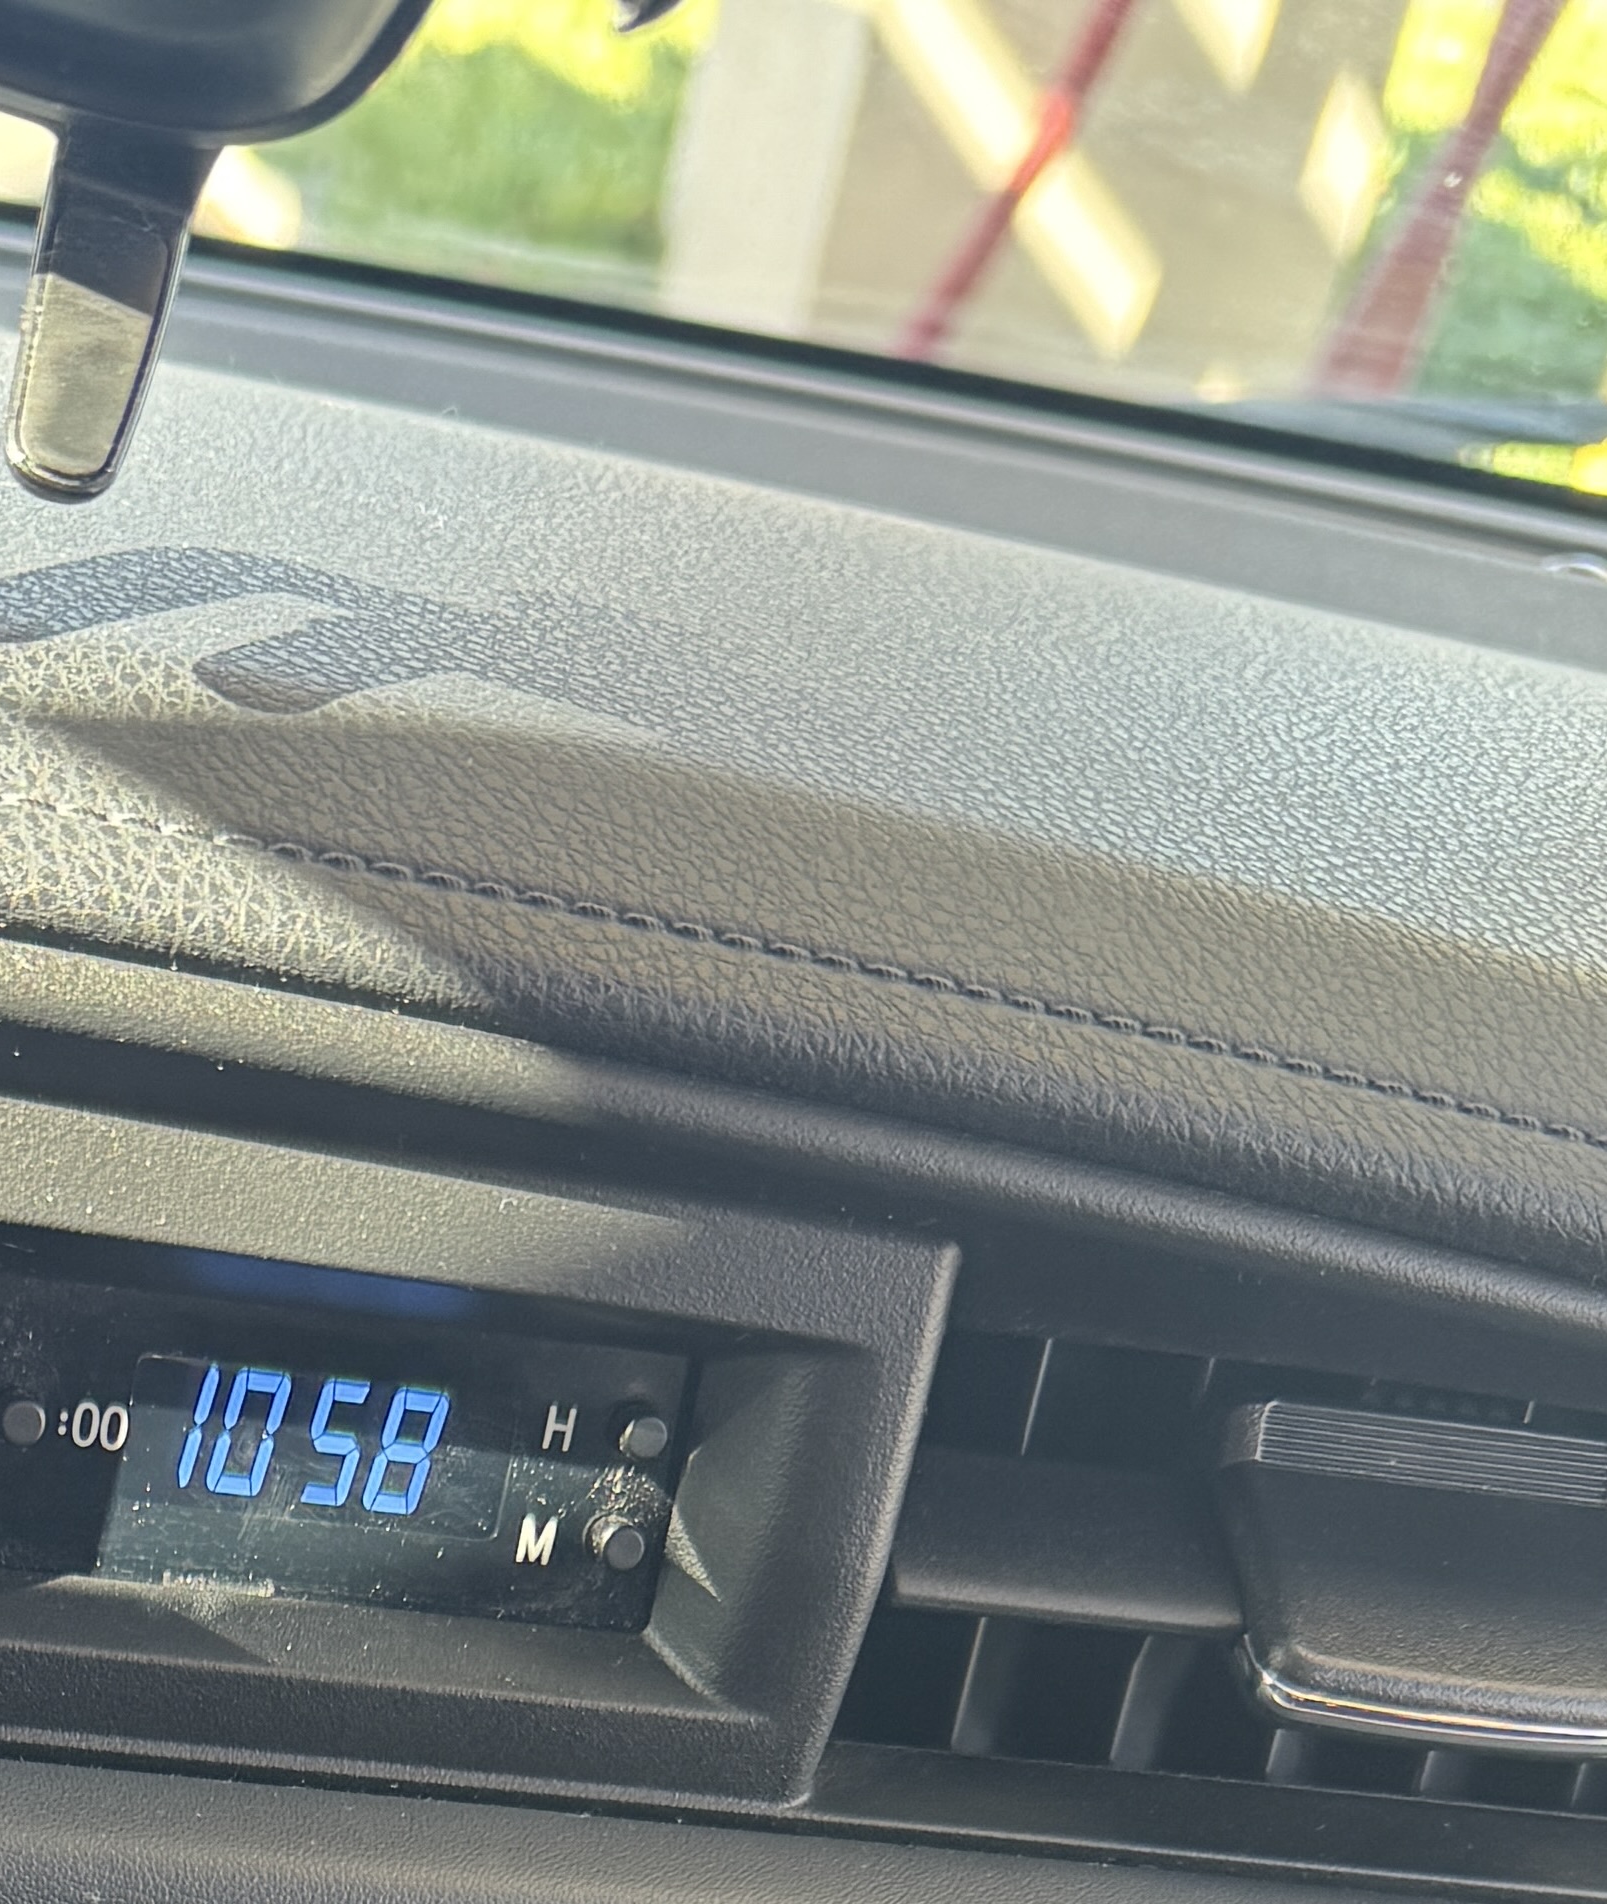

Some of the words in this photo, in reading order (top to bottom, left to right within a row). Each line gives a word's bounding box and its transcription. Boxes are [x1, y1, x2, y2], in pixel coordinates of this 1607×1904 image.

[58, 1401, 129, 1451] :00
[542, 1404, 578, 1452] H
[515, 1513, 558, 1565] M
